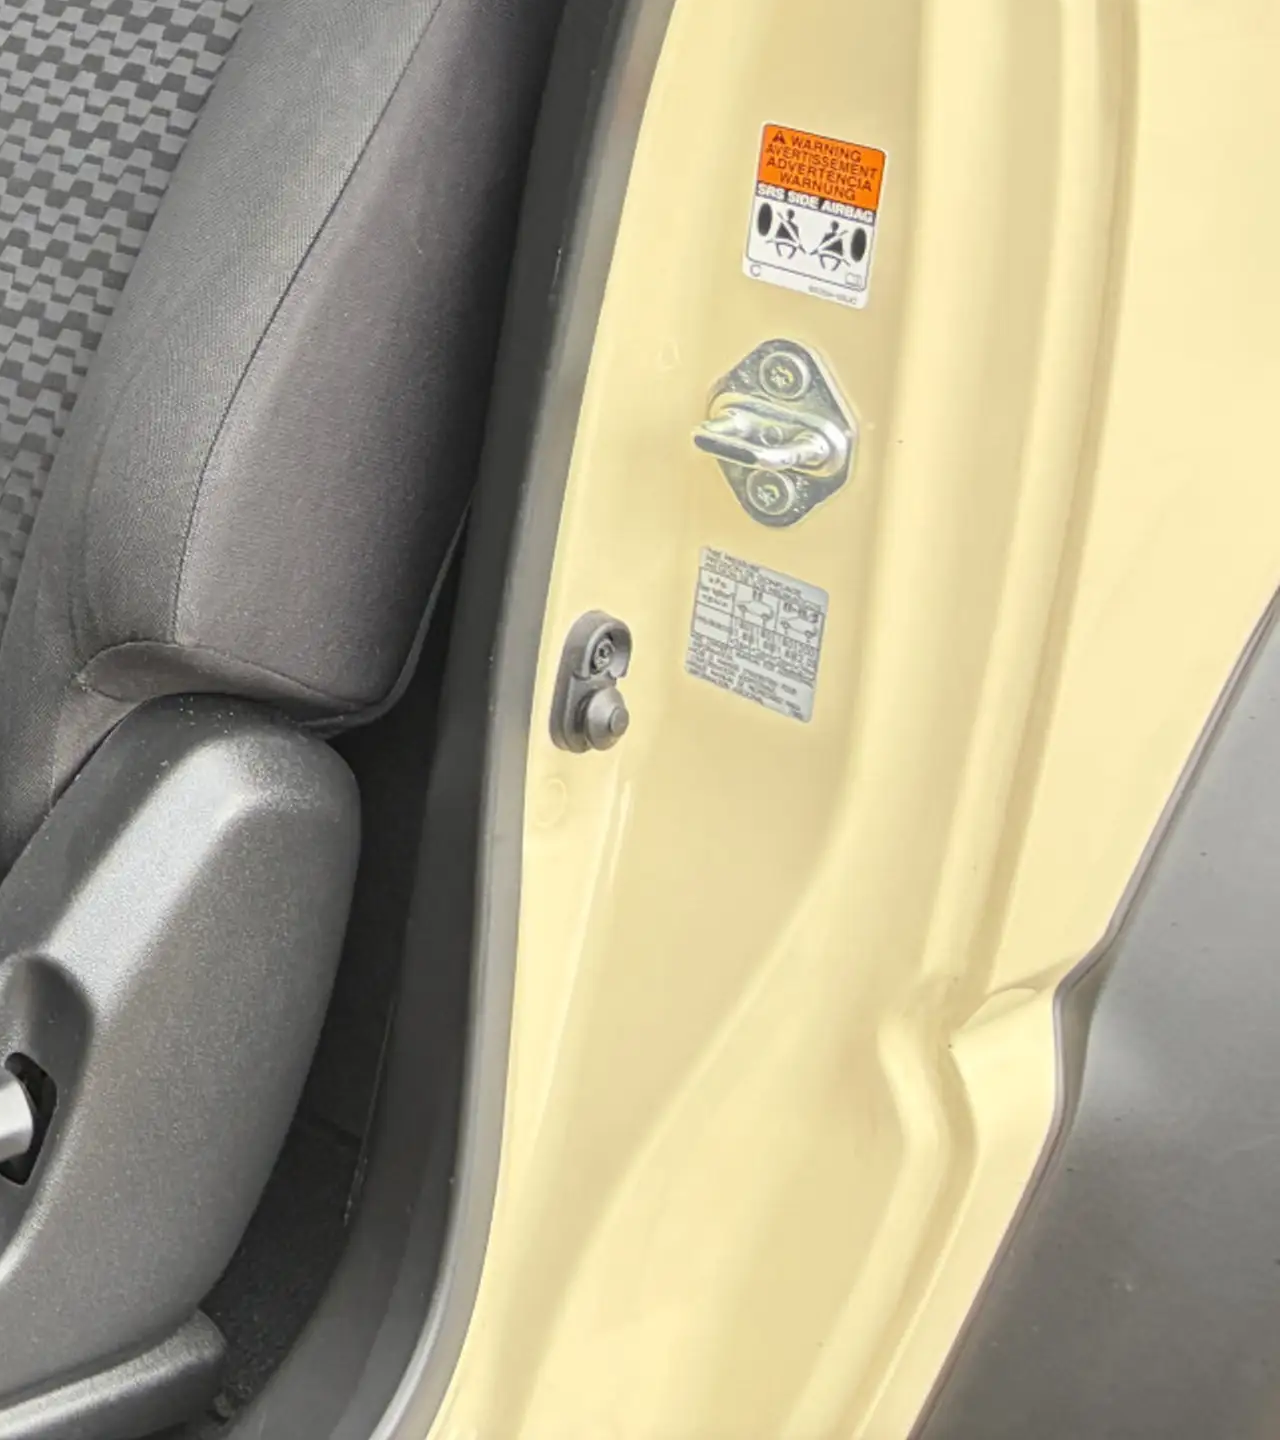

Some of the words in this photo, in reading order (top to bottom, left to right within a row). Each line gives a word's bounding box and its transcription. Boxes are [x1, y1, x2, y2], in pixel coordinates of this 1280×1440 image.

[766, 143, 877, 179] AVERTISSEMENT
[791, 136, 861, 162] WARNING
[766, 157, 871, 192] ADVERTENCIA
[780, 171, 855, 200] WARNUNG
